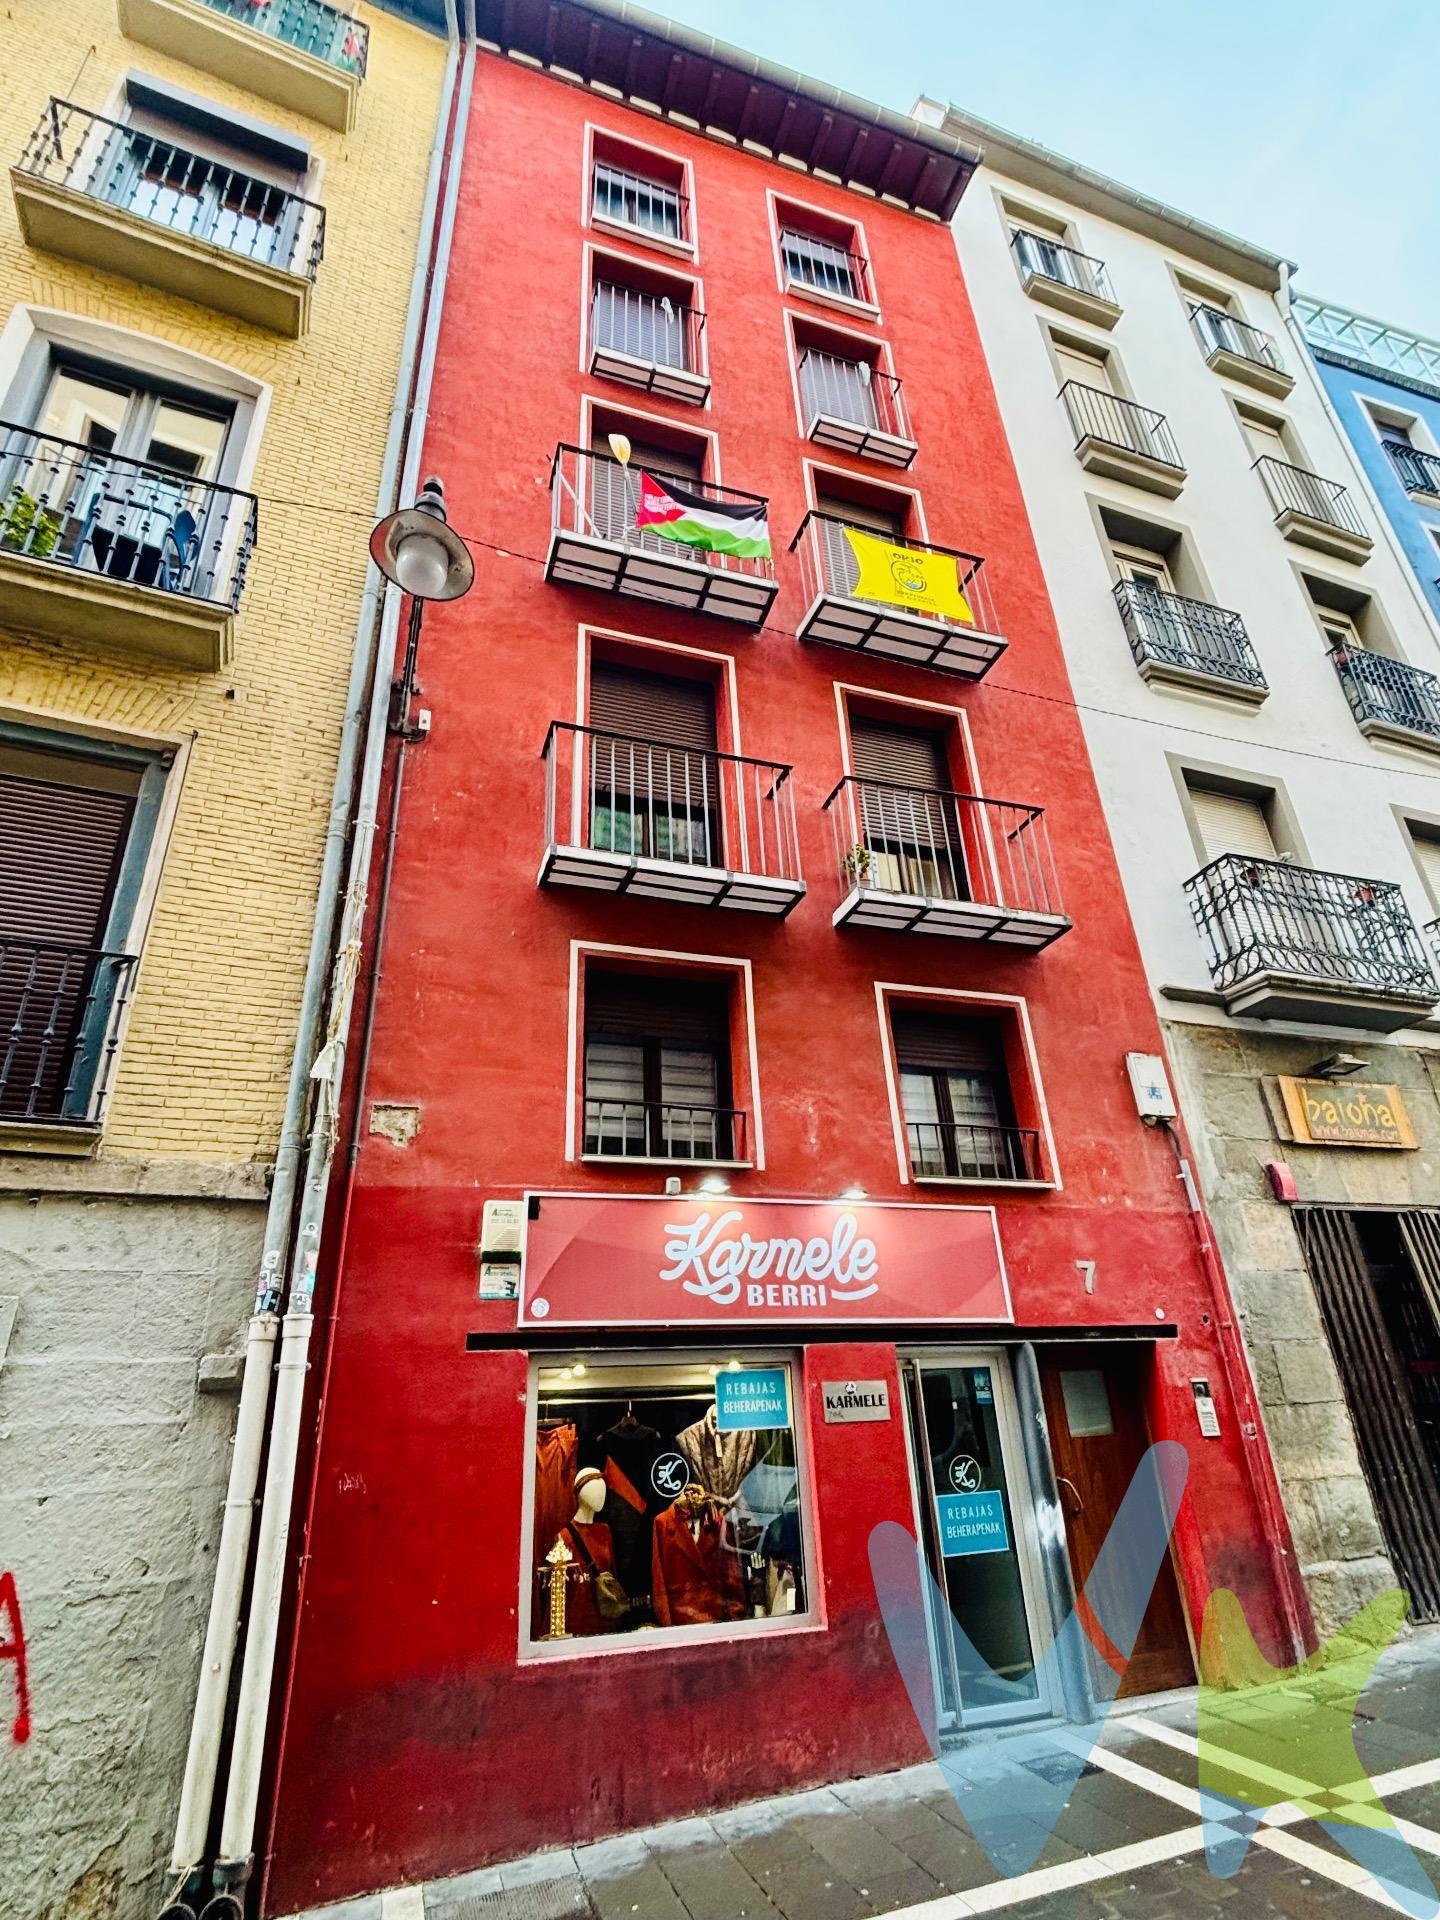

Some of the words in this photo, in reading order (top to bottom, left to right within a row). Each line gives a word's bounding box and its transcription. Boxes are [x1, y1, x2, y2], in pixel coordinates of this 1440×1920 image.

[659, 1211, 879, 1304] Karmele
[1075, 1260, 1096, 1295] 7
[747, 1284, 827, 1306] BERRI
[726, 1382, 776, 1395] REBAJAS
[723, 1400, 782, 1413] BEHERAPENAK
[826, 1394, 886, 1409] KARMELE
[947, 1504, 993, 1520] REBAJAS
[946, 1522, 1001, 1539] BEHERAPENAK
